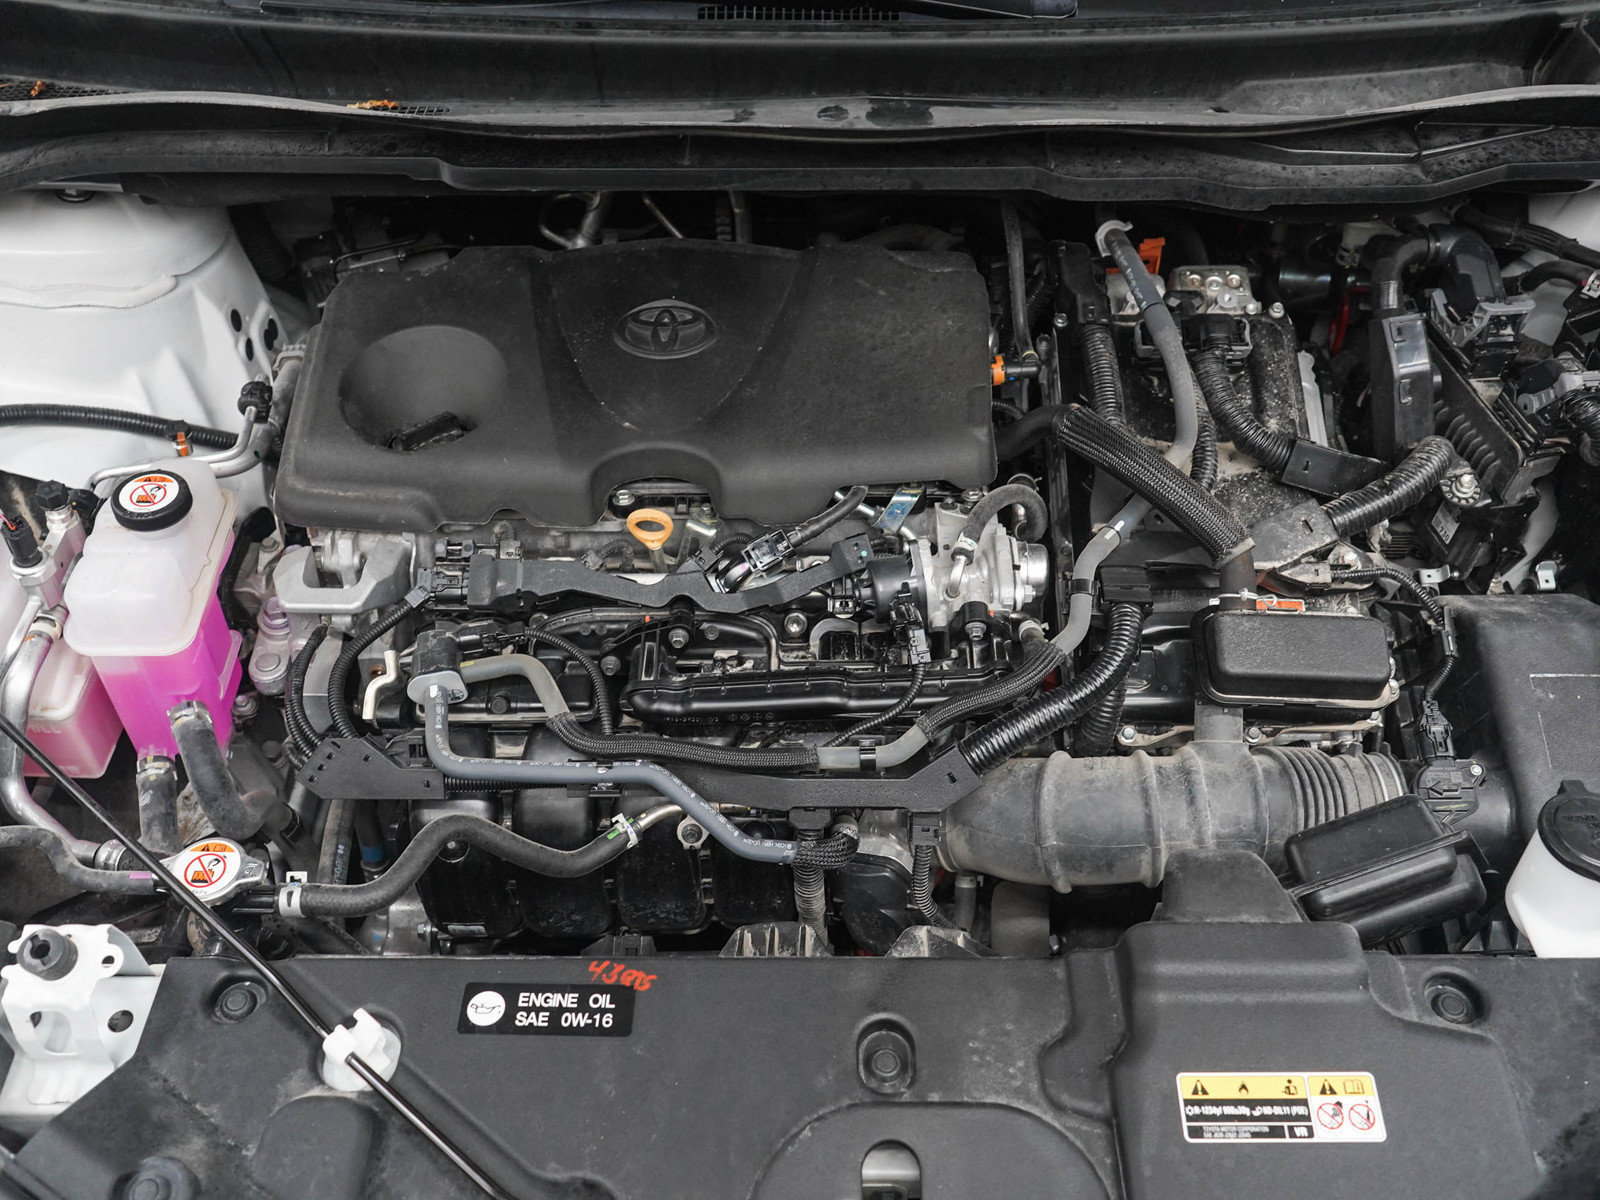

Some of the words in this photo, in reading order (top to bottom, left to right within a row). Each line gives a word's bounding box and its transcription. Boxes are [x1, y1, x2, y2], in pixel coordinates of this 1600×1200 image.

[518, 992, 579, 1008] ENGINE
[588, 993, 616, 1009] OIL
[514, 1011, 550, 1027] SAE
[560, 1012, 614, 1028] 0W-16
[1293, 1126, 1309, 1138] VR
